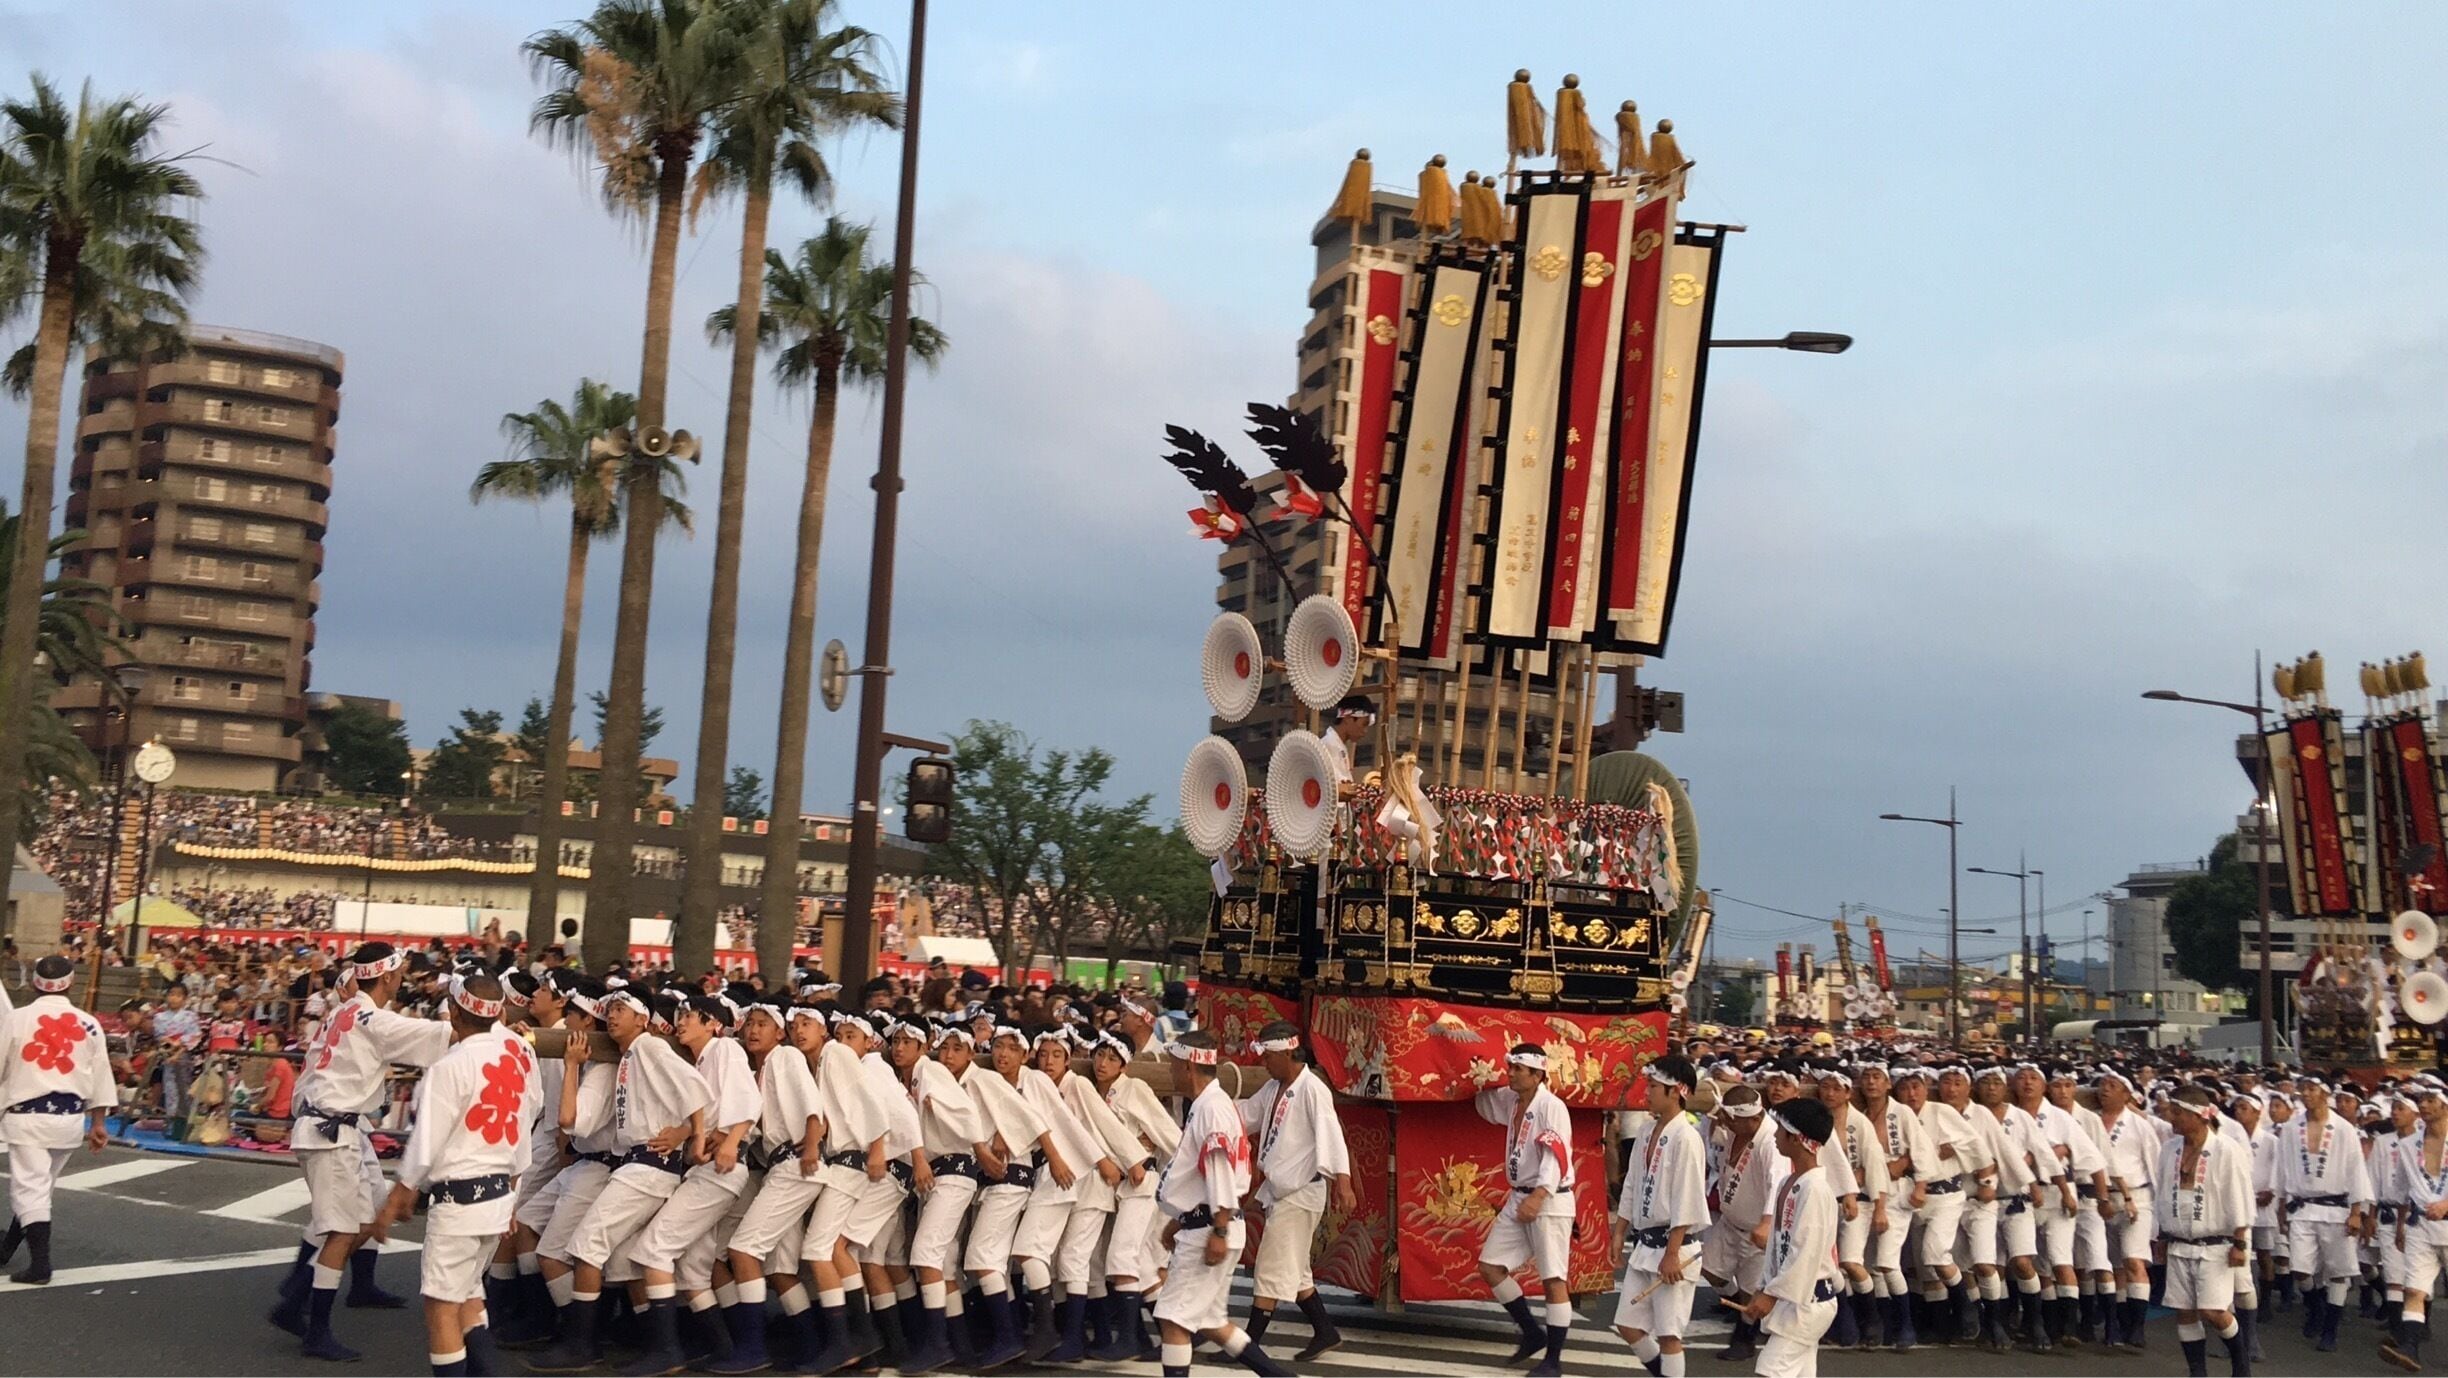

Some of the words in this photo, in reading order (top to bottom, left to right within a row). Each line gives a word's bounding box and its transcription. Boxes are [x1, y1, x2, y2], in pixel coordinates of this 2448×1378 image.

[1564, 426, 1581, 471] 奉納
[459, 991, 499, 1015] 小東山
[1190, 1048, 1216, 1064] 小東
[616, 1085, 627, 1129] 小東山笠
[1259, 1126, 1279, 1163] 小東山笠
[1888, 1122, 1902, 1155] 小東山笠
[1724, 1173, 1740, 1204] 小東山笠
[2192, 1184, 2205, 1221] 小東山笠
